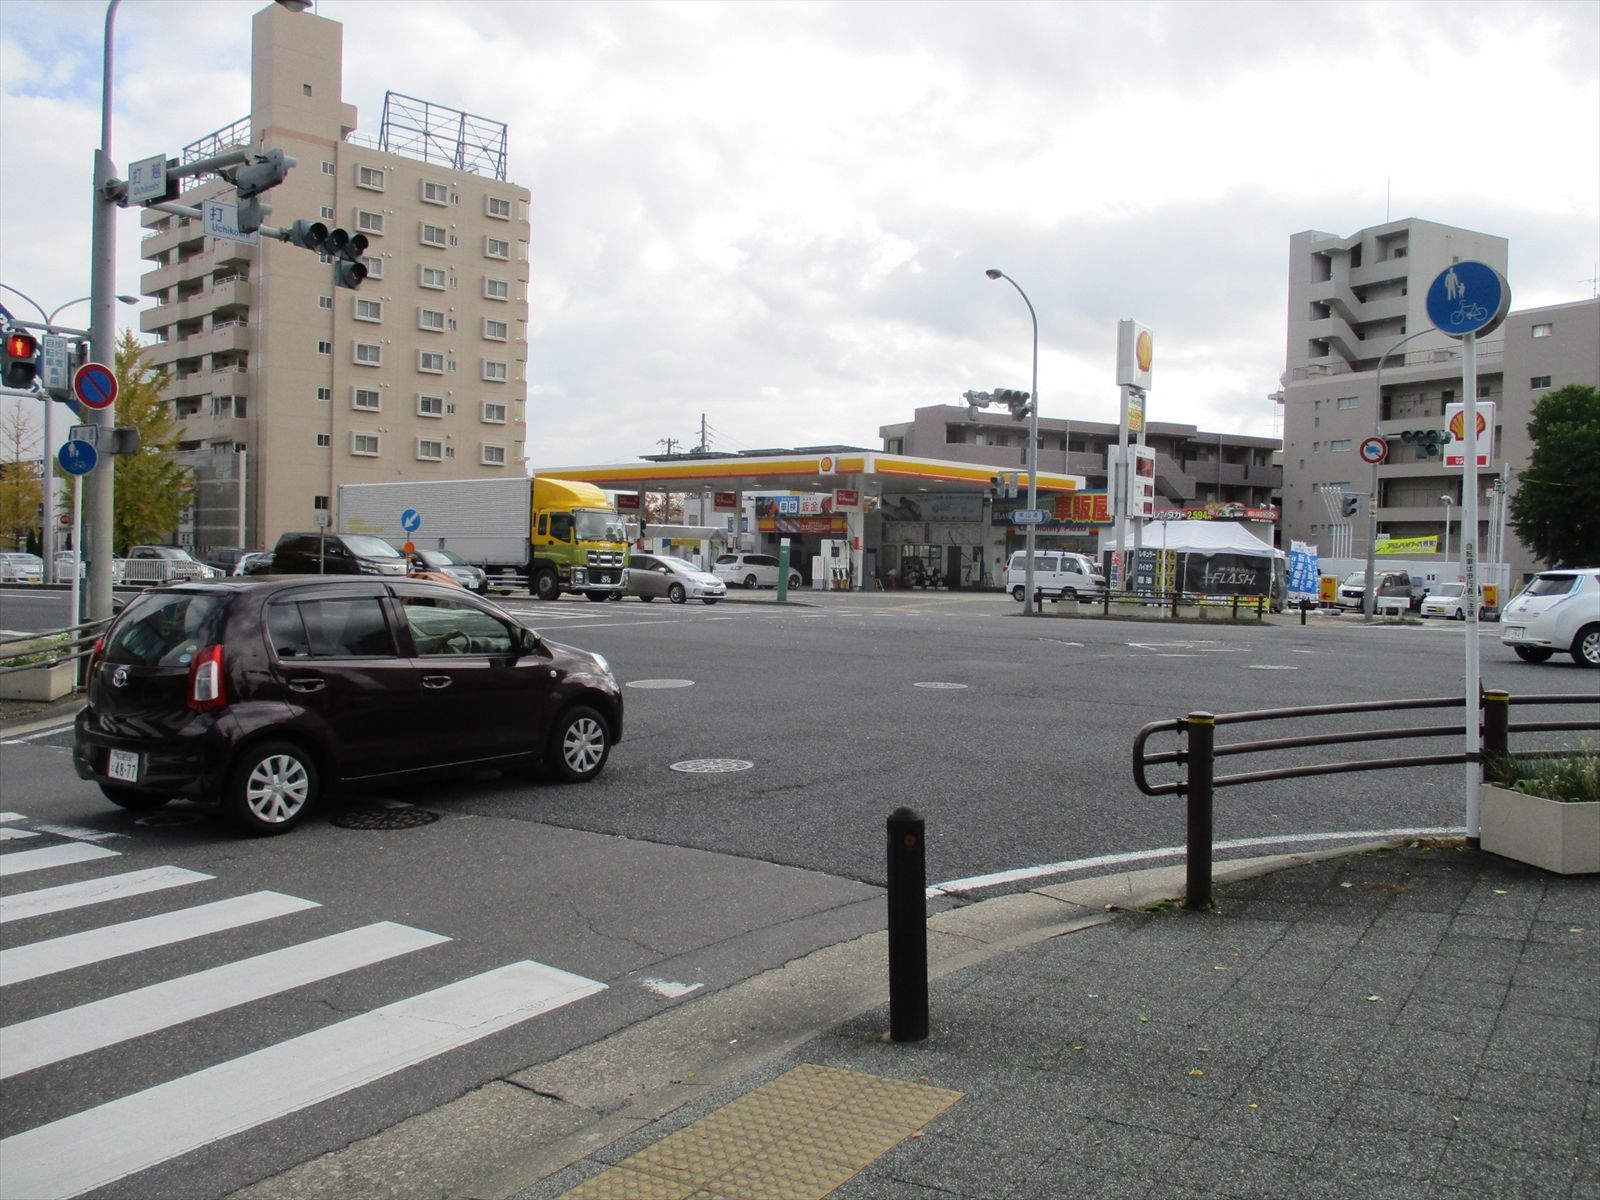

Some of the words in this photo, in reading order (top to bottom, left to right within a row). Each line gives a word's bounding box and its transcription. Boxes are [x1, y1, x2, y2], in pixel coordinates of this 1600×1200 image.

[1054, 495, 1112, 522] 車販屋
[1138, 563, 1153, 571] ハイオク
